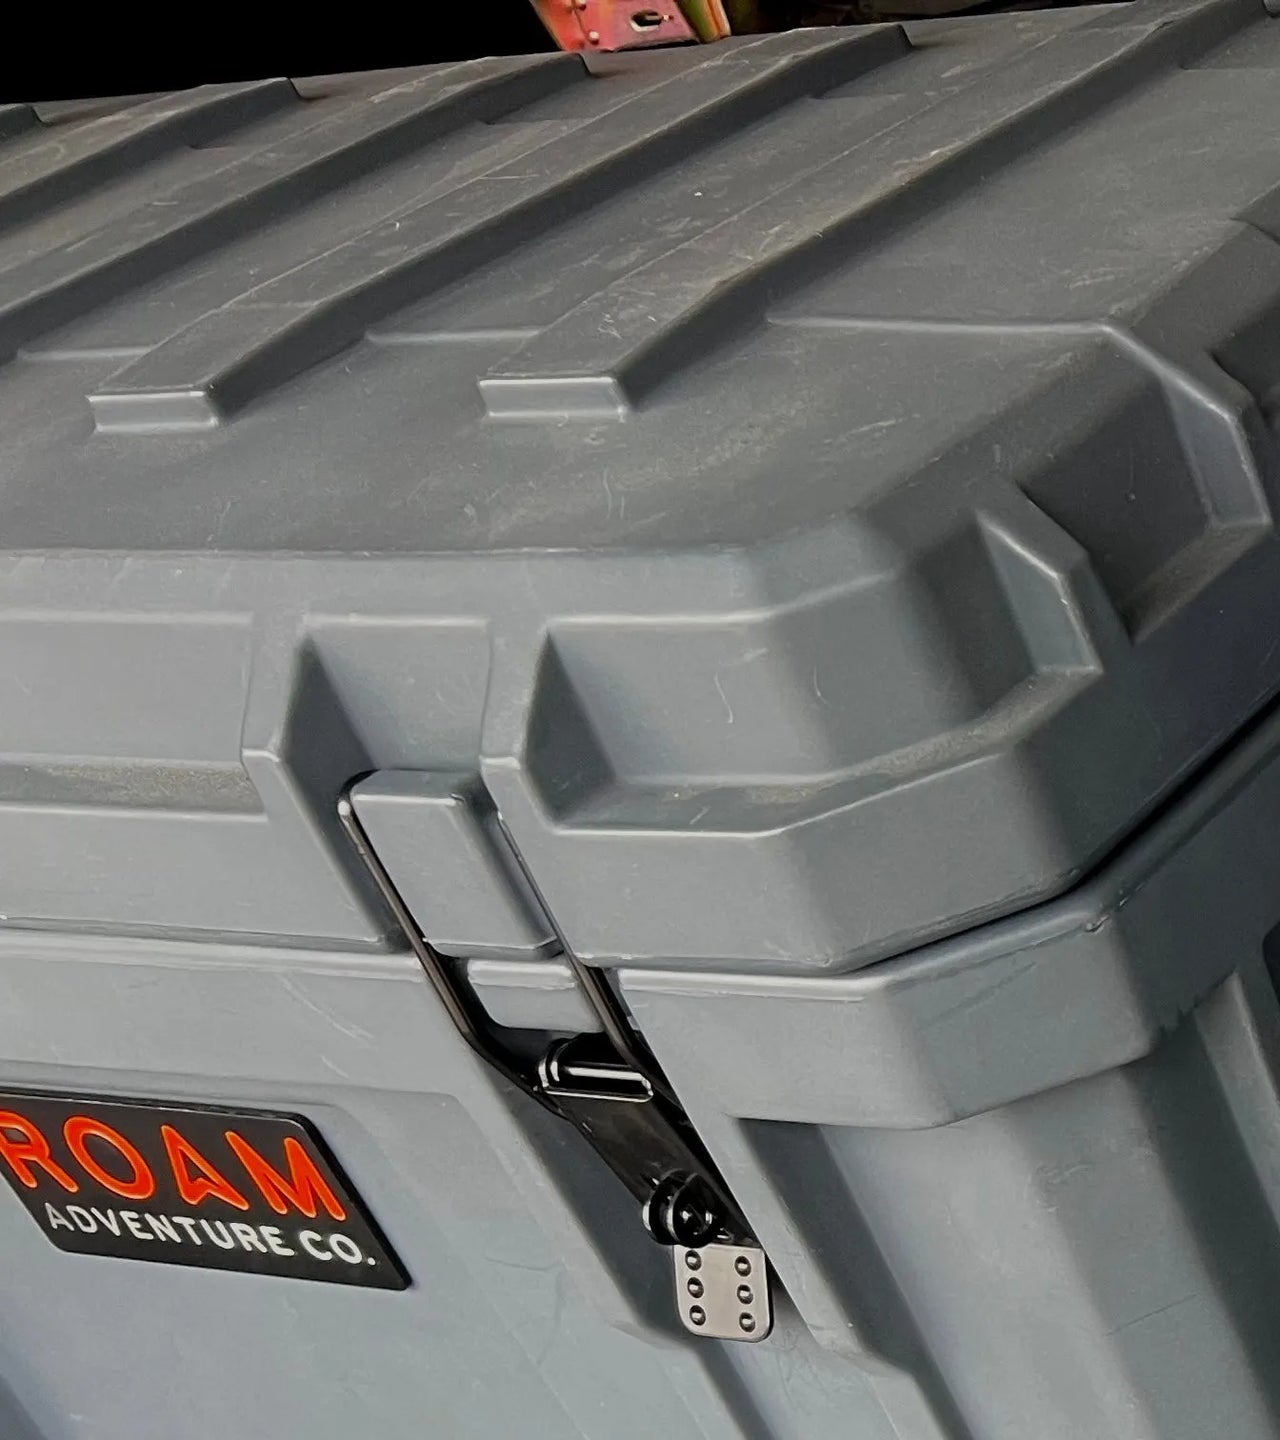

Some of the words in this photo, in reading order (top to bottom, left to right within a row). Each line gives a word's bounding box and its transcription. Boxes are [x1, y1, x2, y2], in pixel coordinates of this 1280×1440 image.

[0, 1110, 347, 1221] ROAM
[45, 1202, 295, 1257] ADVENTURE
[299, 1230, 376, 1266] CO.
